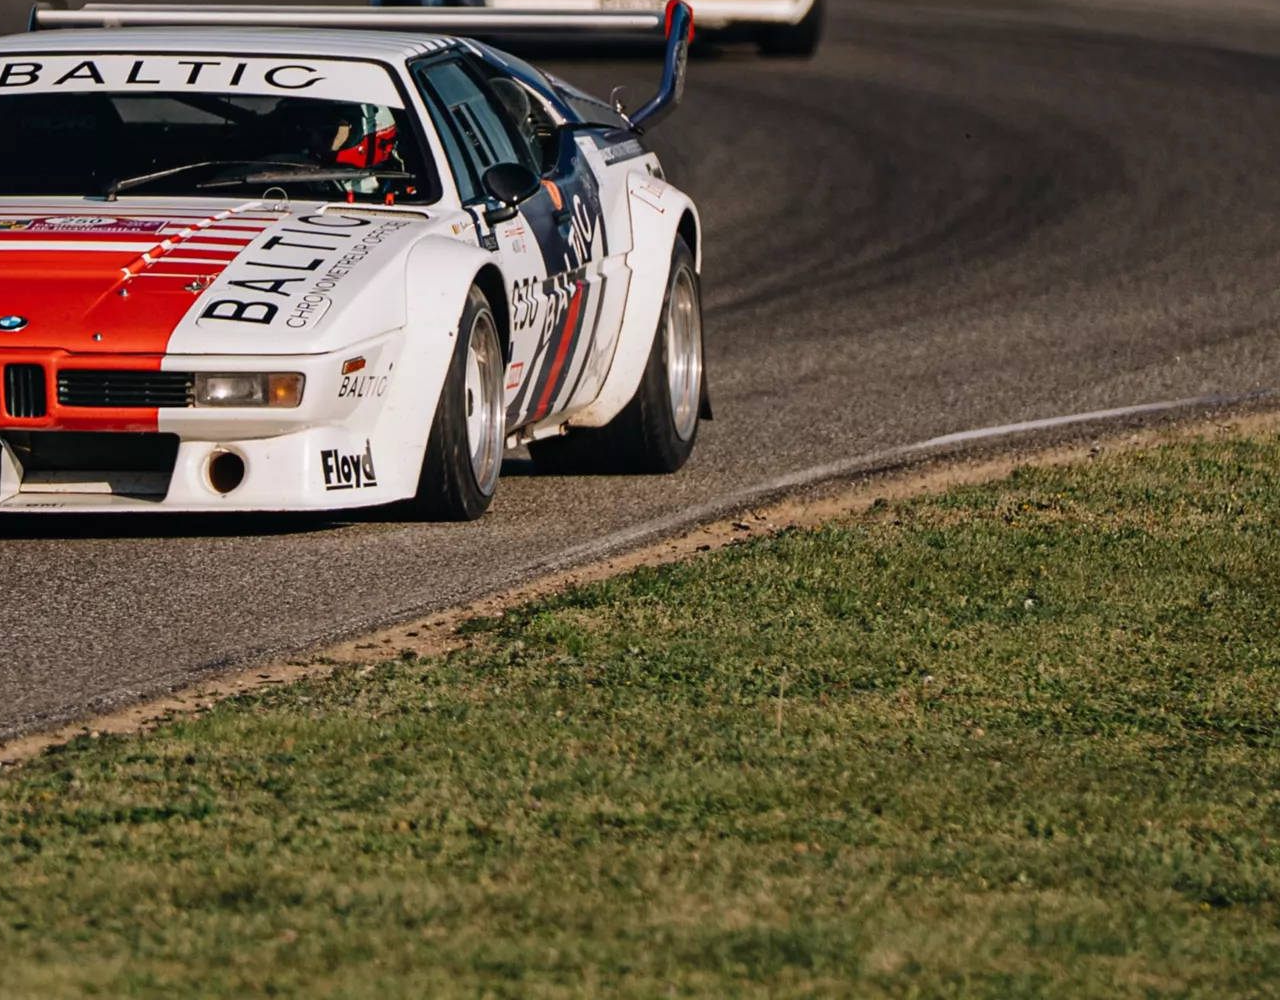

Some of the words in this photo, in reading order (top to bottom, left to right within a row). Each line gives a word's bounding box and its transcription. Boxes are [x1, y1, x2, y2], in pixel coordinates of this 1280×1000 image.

[200, 215, 371, 325] BALTIC
[338, 376, 387, 398] BALTIC
[320, 438, 377, 490] Floyd
